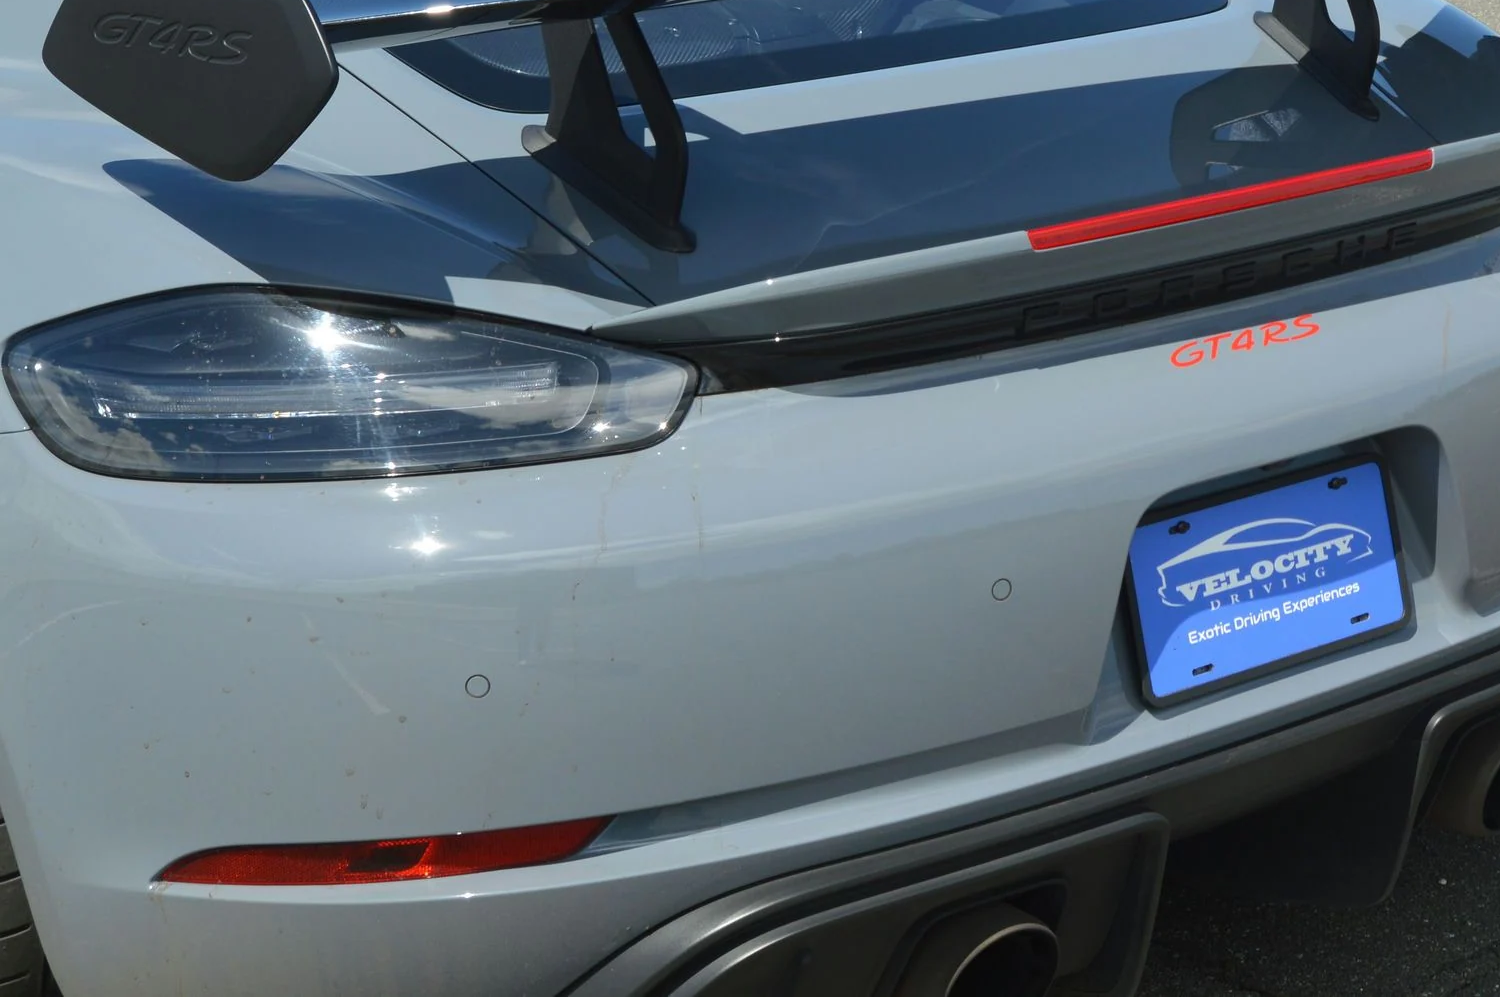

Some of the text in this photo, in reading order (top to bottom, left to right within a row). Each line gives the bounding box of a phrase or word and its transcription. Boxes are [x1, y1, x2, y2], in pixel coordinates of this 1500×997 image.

[93, 12, 252, 65] GT4RS
[1018, 222, 1417, 336] PORSCHE
[1170, 313, 1321, 368] GT4RS
[1176, 534, 1354, 601] VELOCITY
[1210, 566, 1326, 611] DRIVING
[1188, 580, 1360, 644] Exotic Driving Experiences
